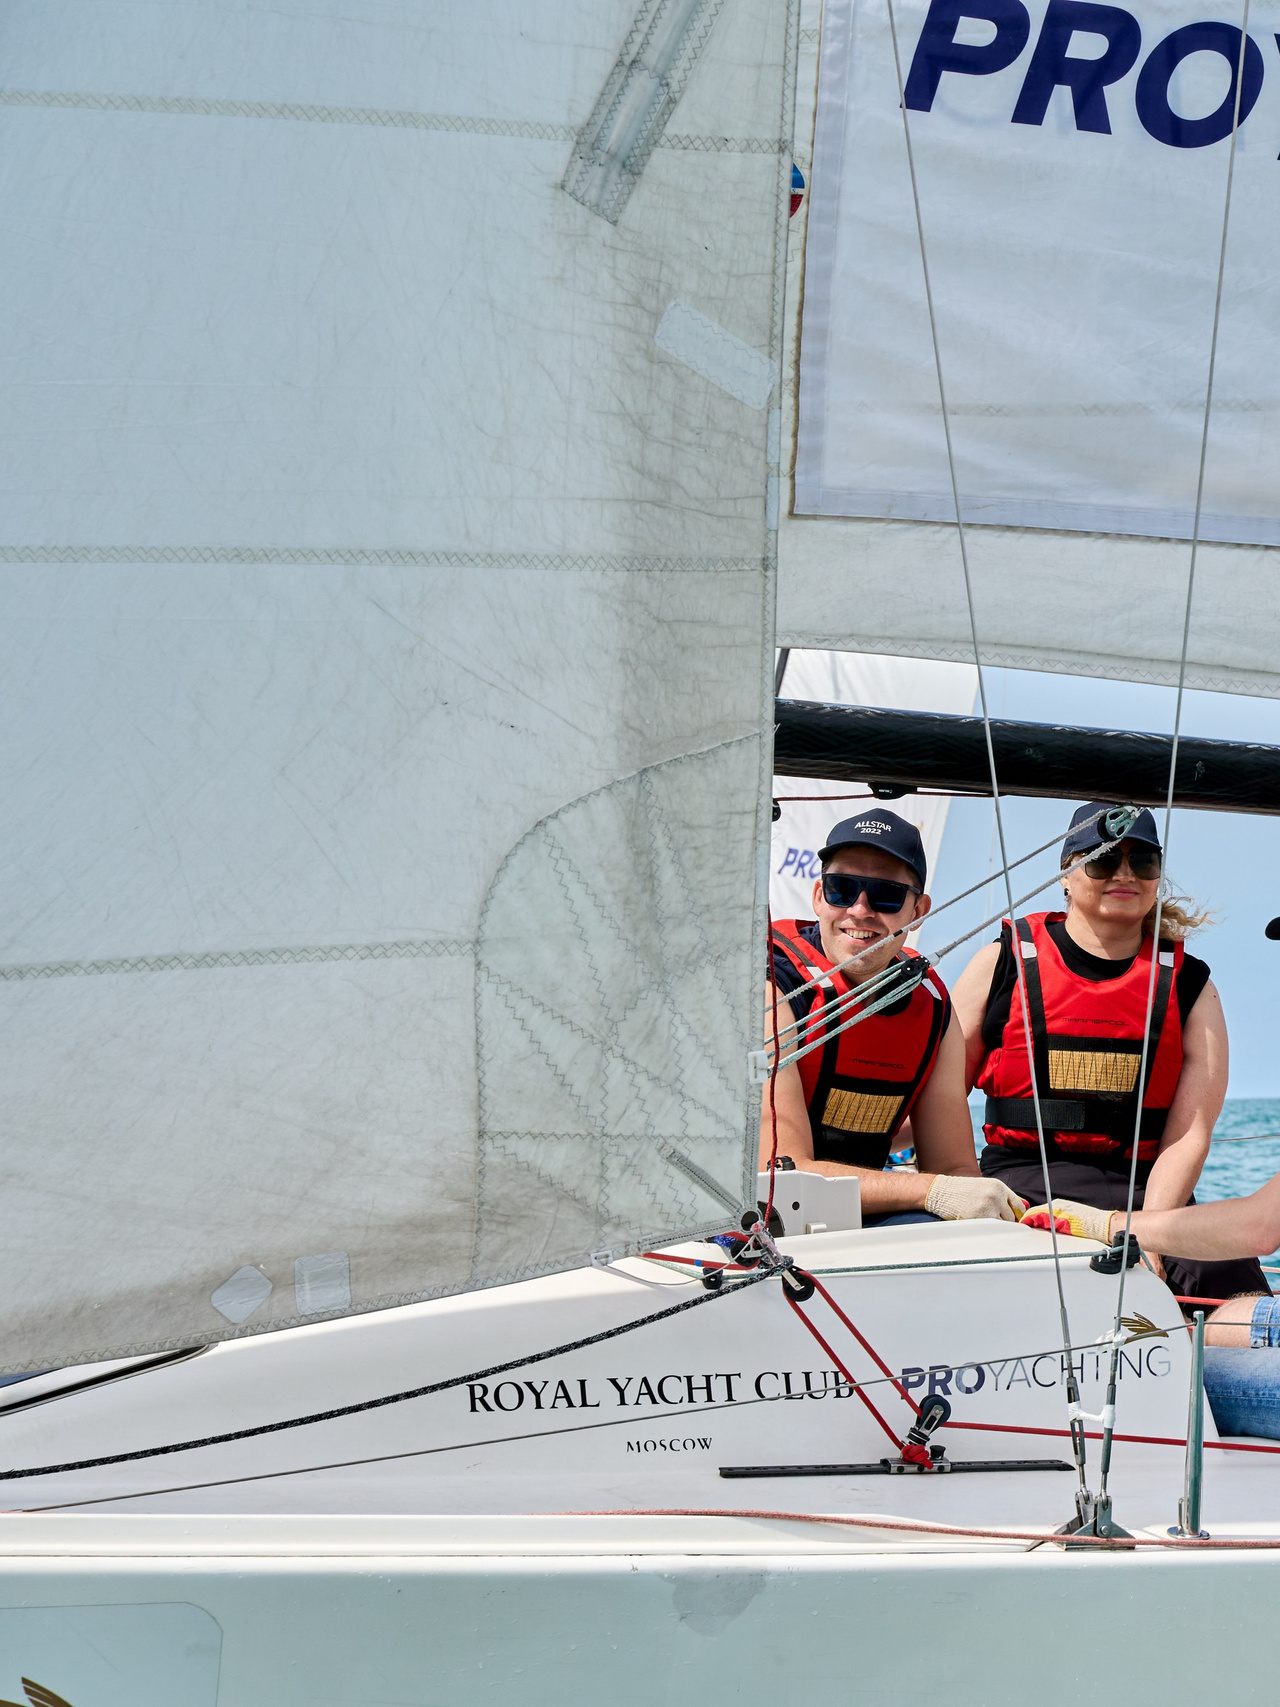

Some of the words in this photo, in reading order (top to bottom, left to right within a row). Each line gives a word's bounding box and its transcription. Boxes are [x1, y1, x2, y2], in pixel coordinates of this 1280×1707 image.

[854, 820, 892, 832] ALLSTAR
[860, 827, 882, 835] 2022
[900, 1345, 1171, 1400] PROYACHTNG
[466, 1379, 600, 1412] ROYAL
[606, 1372, 742, 1406] YACHT
[754, 1370, 855, 1401] CLUB
[626, 1437, 713, 1453] MOSCOW
